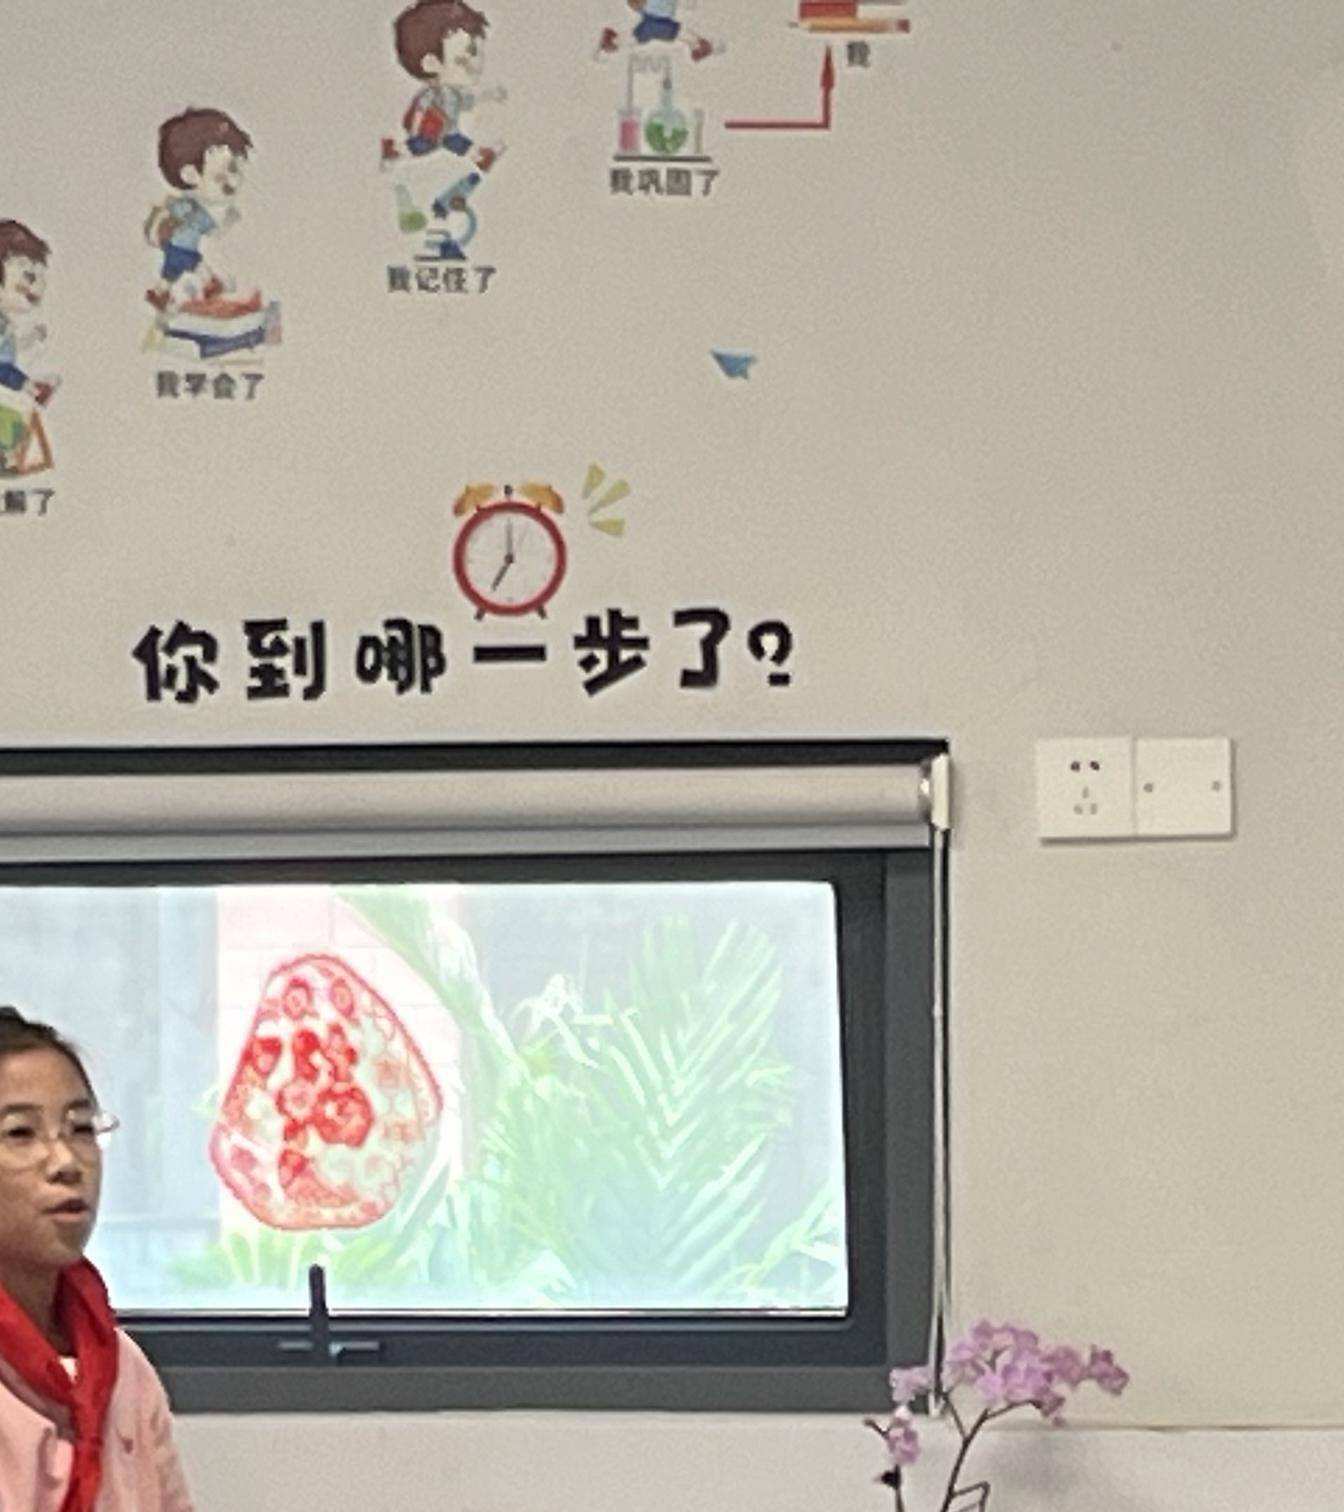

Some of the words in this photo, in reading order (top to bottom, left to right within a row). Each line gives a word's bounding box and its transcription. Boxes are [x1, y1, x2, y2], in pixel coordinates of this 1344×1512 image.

[387, 265, 497, 294] 我记住了
[156, 370, 265, 400] 我学会了
[131, 607, 794, 704] 你到哪一步了?
